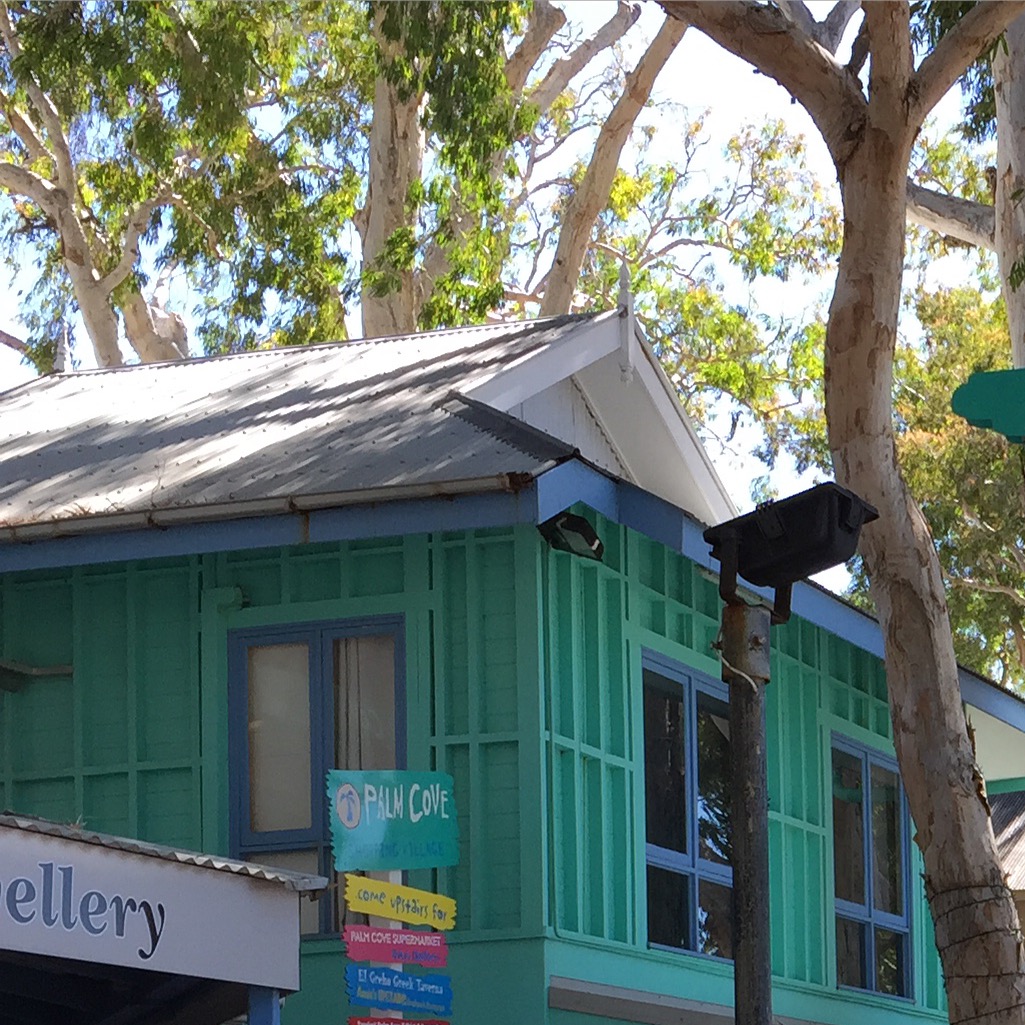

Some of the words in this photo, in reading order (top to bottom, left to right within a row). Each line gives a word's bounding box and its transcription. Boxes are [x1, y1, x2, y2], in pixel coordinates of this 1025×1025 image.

[364, 783, 404, 826] PALM
[409, 783, 450, 824] COVE
[390, 895, 429, 919] upstairs
[432, 903, 448, 920] for
[350, 930, 369, 943] PALM
[371, 932, 391, 945] COVE
[392, 933, 441, 947] SUPERMARKET
